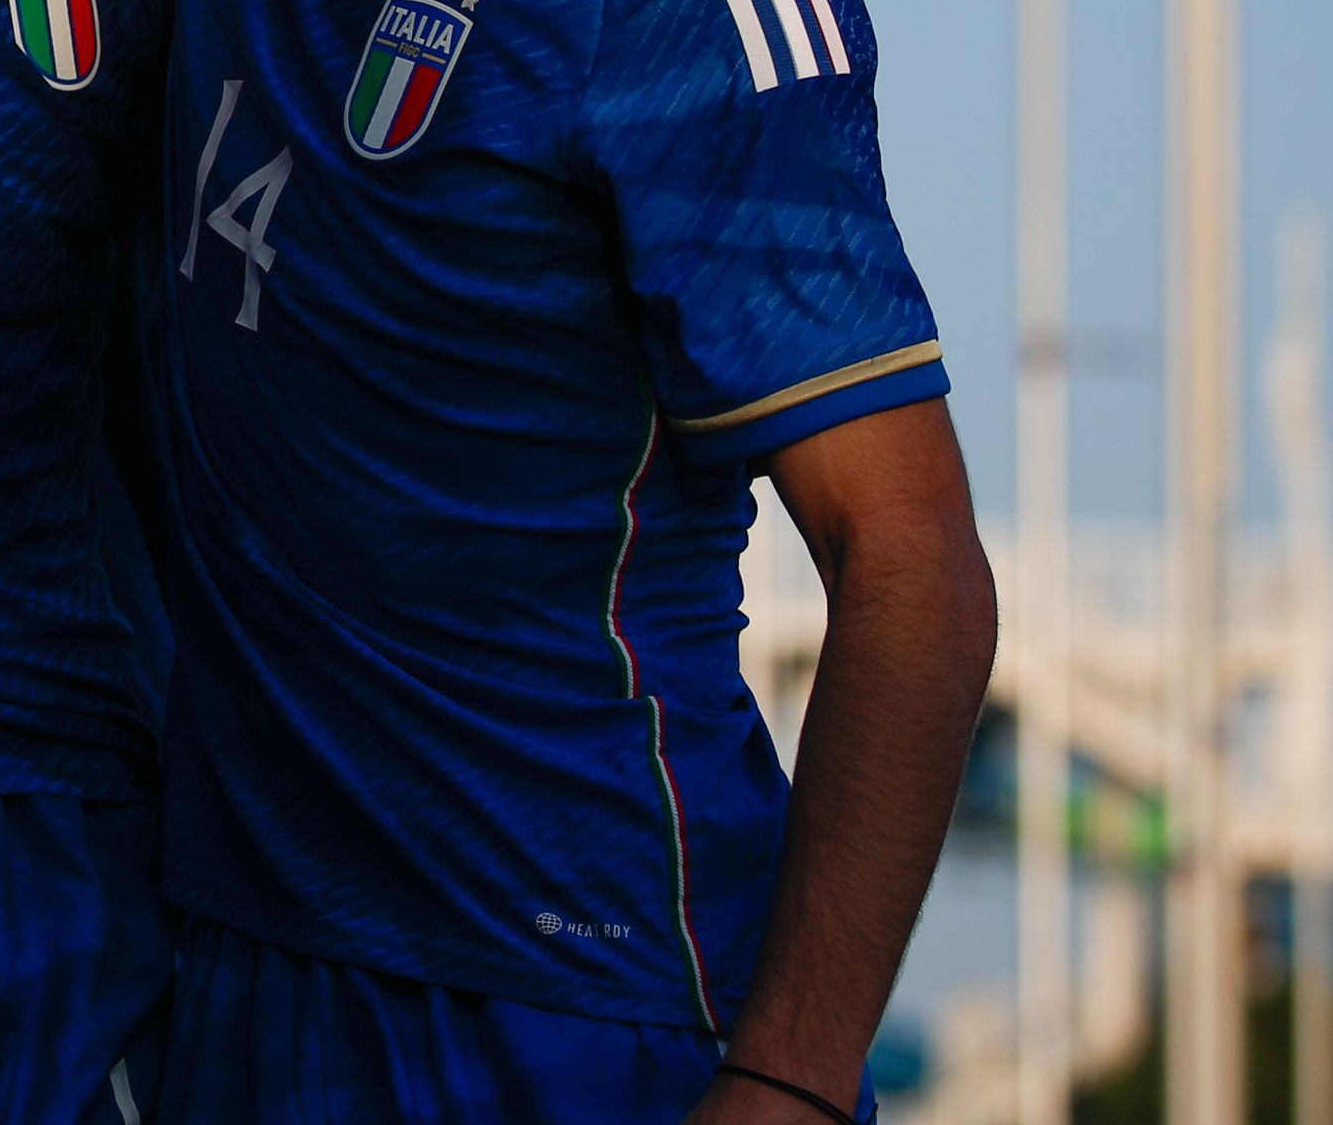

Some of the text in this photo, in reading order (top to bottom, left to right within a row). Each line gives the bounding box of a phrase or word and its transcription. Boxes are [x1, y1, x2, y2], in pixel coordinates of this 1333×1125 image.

[379, 4, 454, 55] ITALIA
[397, 41, 421, 58] FIGC
[179, 79, 295, 332] 14
